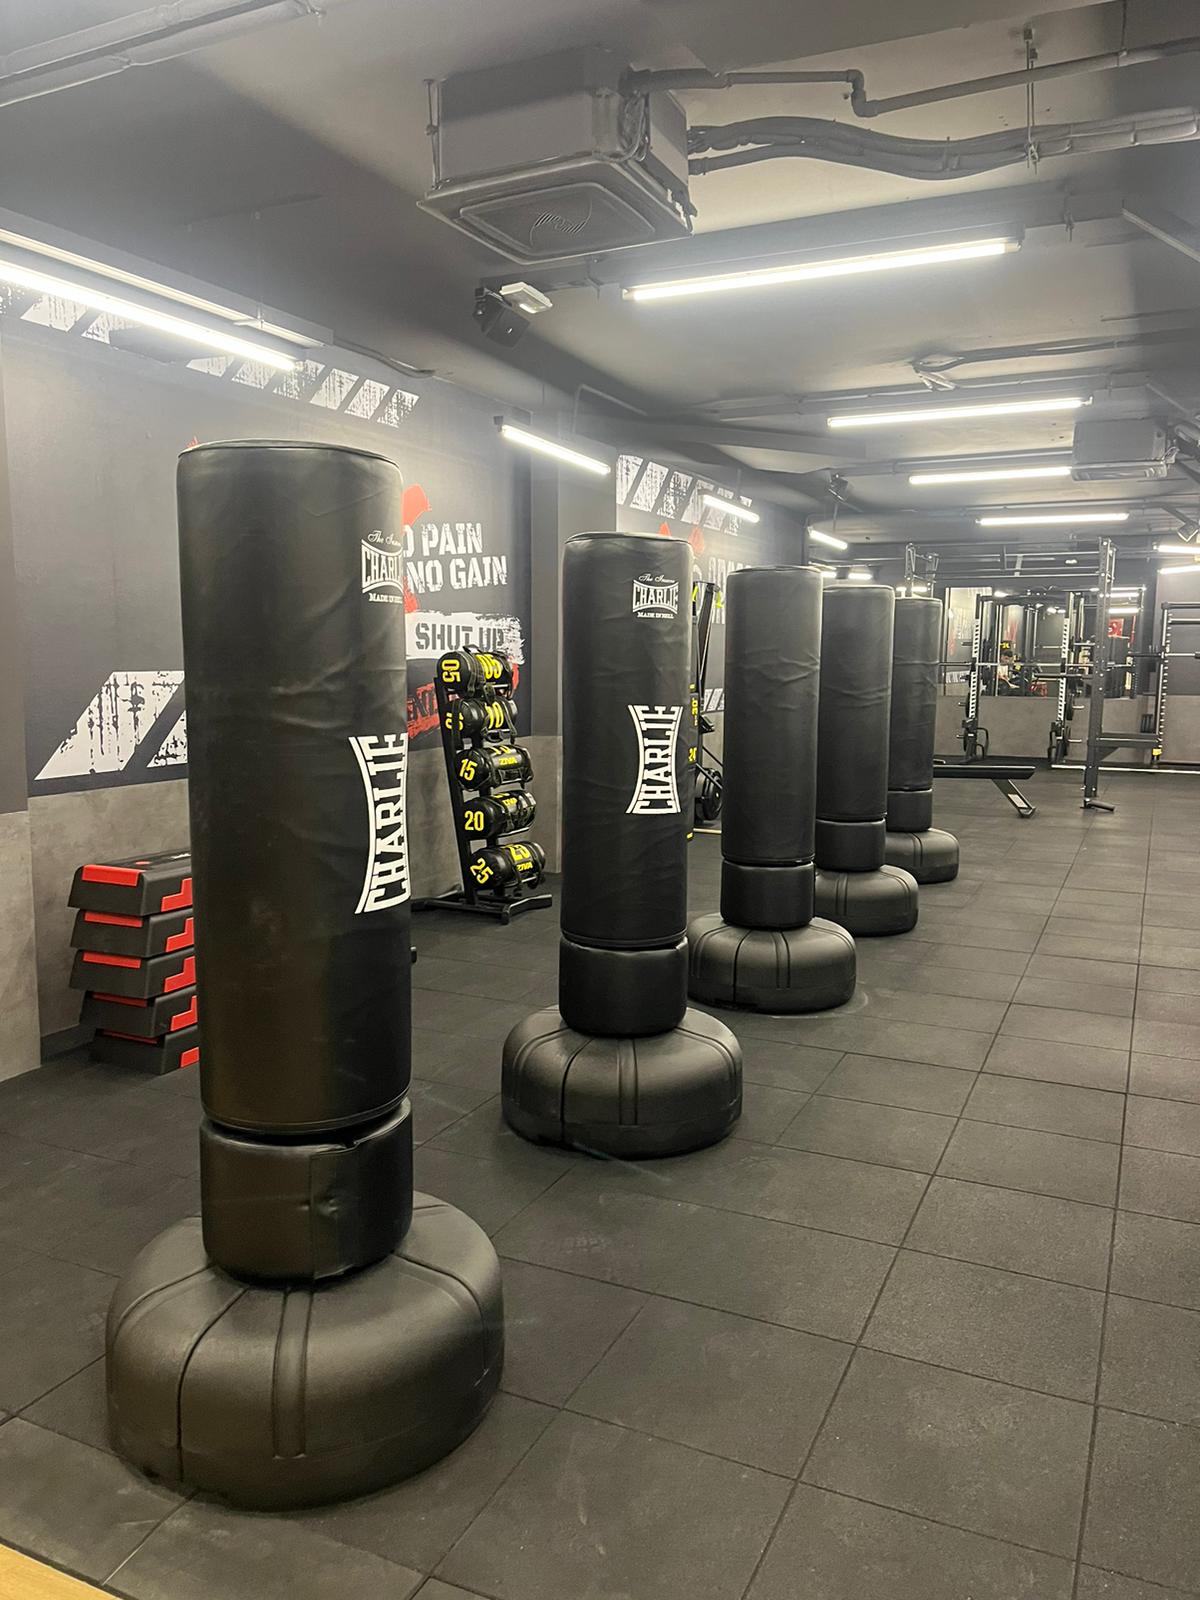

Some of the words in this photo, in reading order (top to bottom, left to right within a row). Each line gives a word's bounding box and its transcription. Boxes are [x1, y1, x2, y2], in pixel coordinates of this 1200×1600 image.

[421, 522, 483, 556] PAIN
[406, 559, 444, 594] NO
[449, 555, 507, 590] GAIN
[633, 582, 679, 611] CHARLIE
[415, 622, 473, 651] SHUT
[479, 627, 505, 652] UP
[441, 659, 461, 683] 05
[459, 758, 478, 781] 15
[632, 705, 680, 814] CHARLIE
[357, 733, 411, 913] CHARLIE
[464, 810, 485, 831] 20
[469, 857, 494, 885] 25
